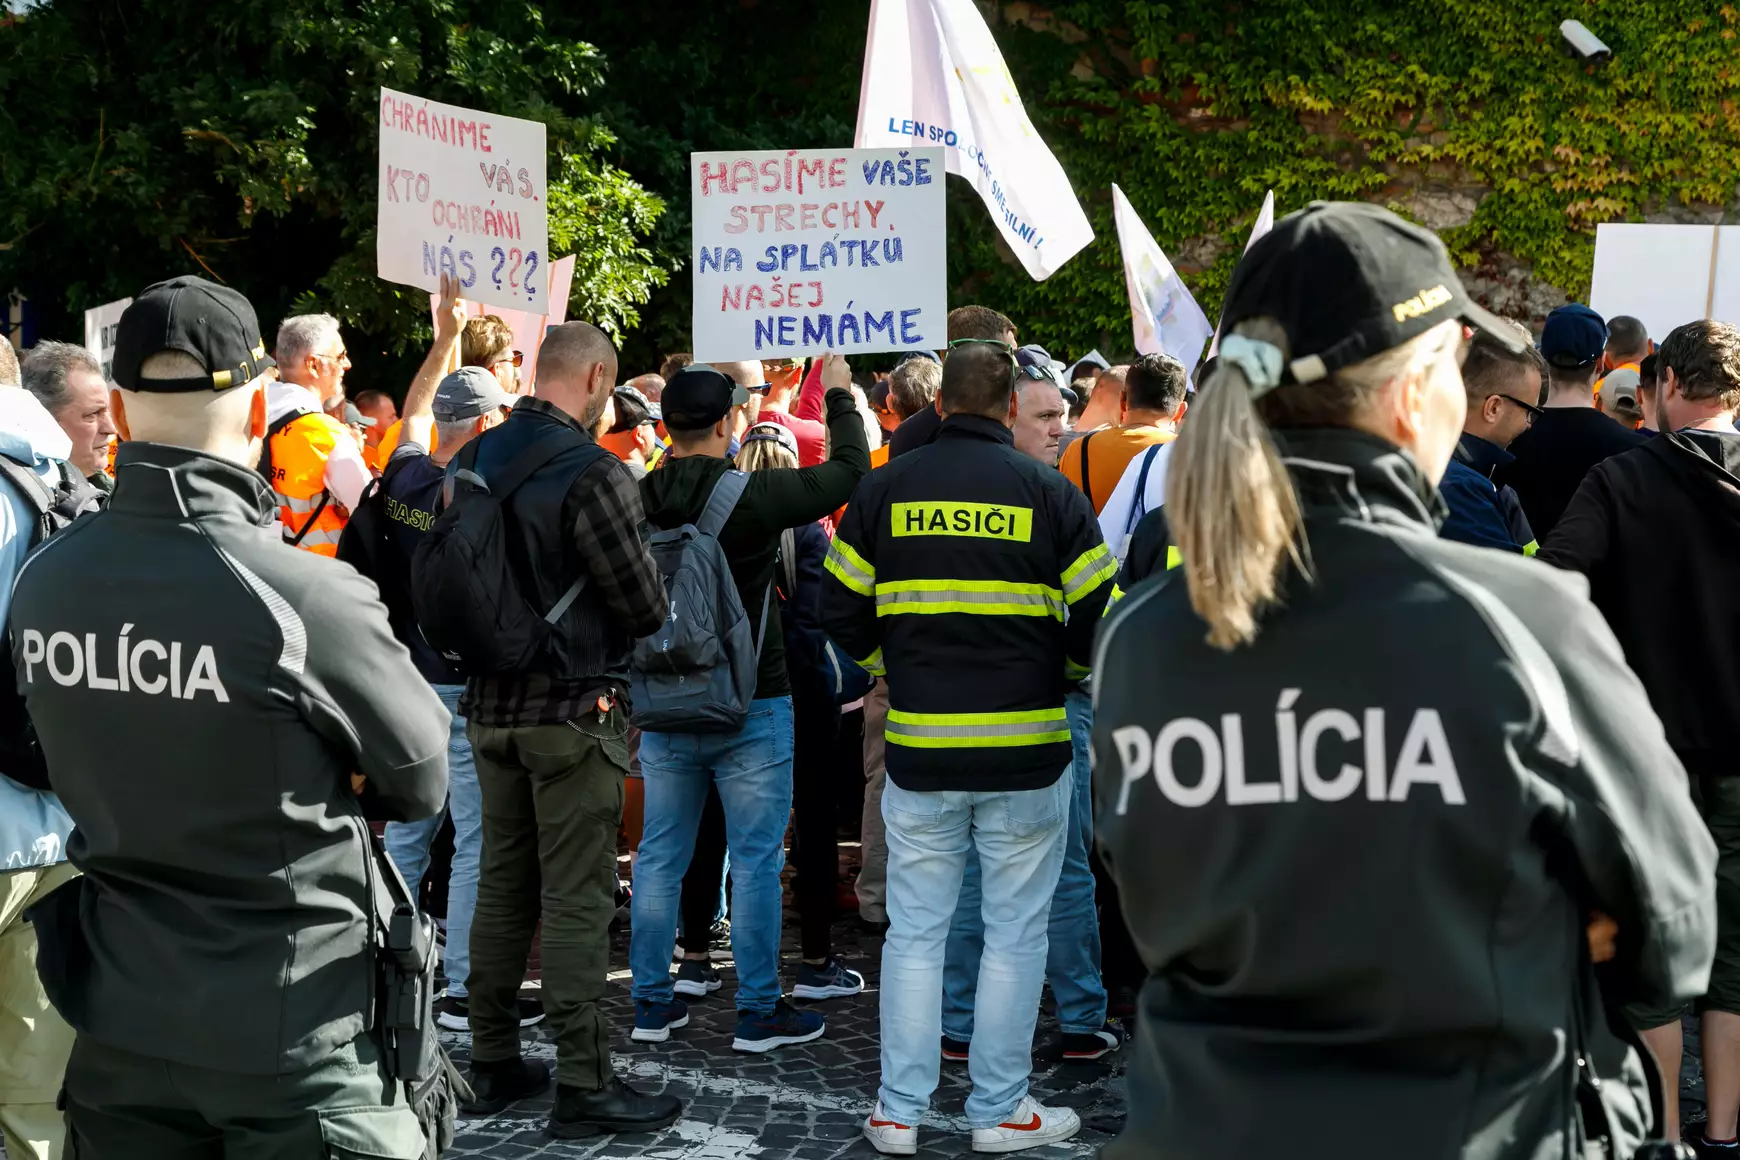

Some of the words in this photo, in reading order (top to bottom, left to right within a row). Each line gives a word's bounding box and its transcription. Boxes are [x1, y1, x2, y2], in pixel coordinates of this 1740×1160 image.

[382, 95, 492, 153] CHRÁNIME
[888, 117, 925, 138] LEN
[387, 164, 430, 203] KTO
[479, 159, 539, 201] VÁS.
[700, 149, 848, 197] HASÍME
[862, 151, 932, 187] VAŠE
[432, 199, 521, 240] OCHRÁNI
[723, 200, 894, 235] STRECHY.
[422, 234, 477, 288] NÁS
[491, 246, 539, 302] ???
[699, 246, 743, 274] NA
[756, 233, 903, 273] SPLÁTKU
[721, 276, 824, 312] NAŠEJ
[754, 300, 925, 350] NEMÁME
[906, 507, 1015, 536] HASIČI
[23, 622, 231, 703] POLÍCIA
[1112, 687, 1467, 816] POLÍCIA
